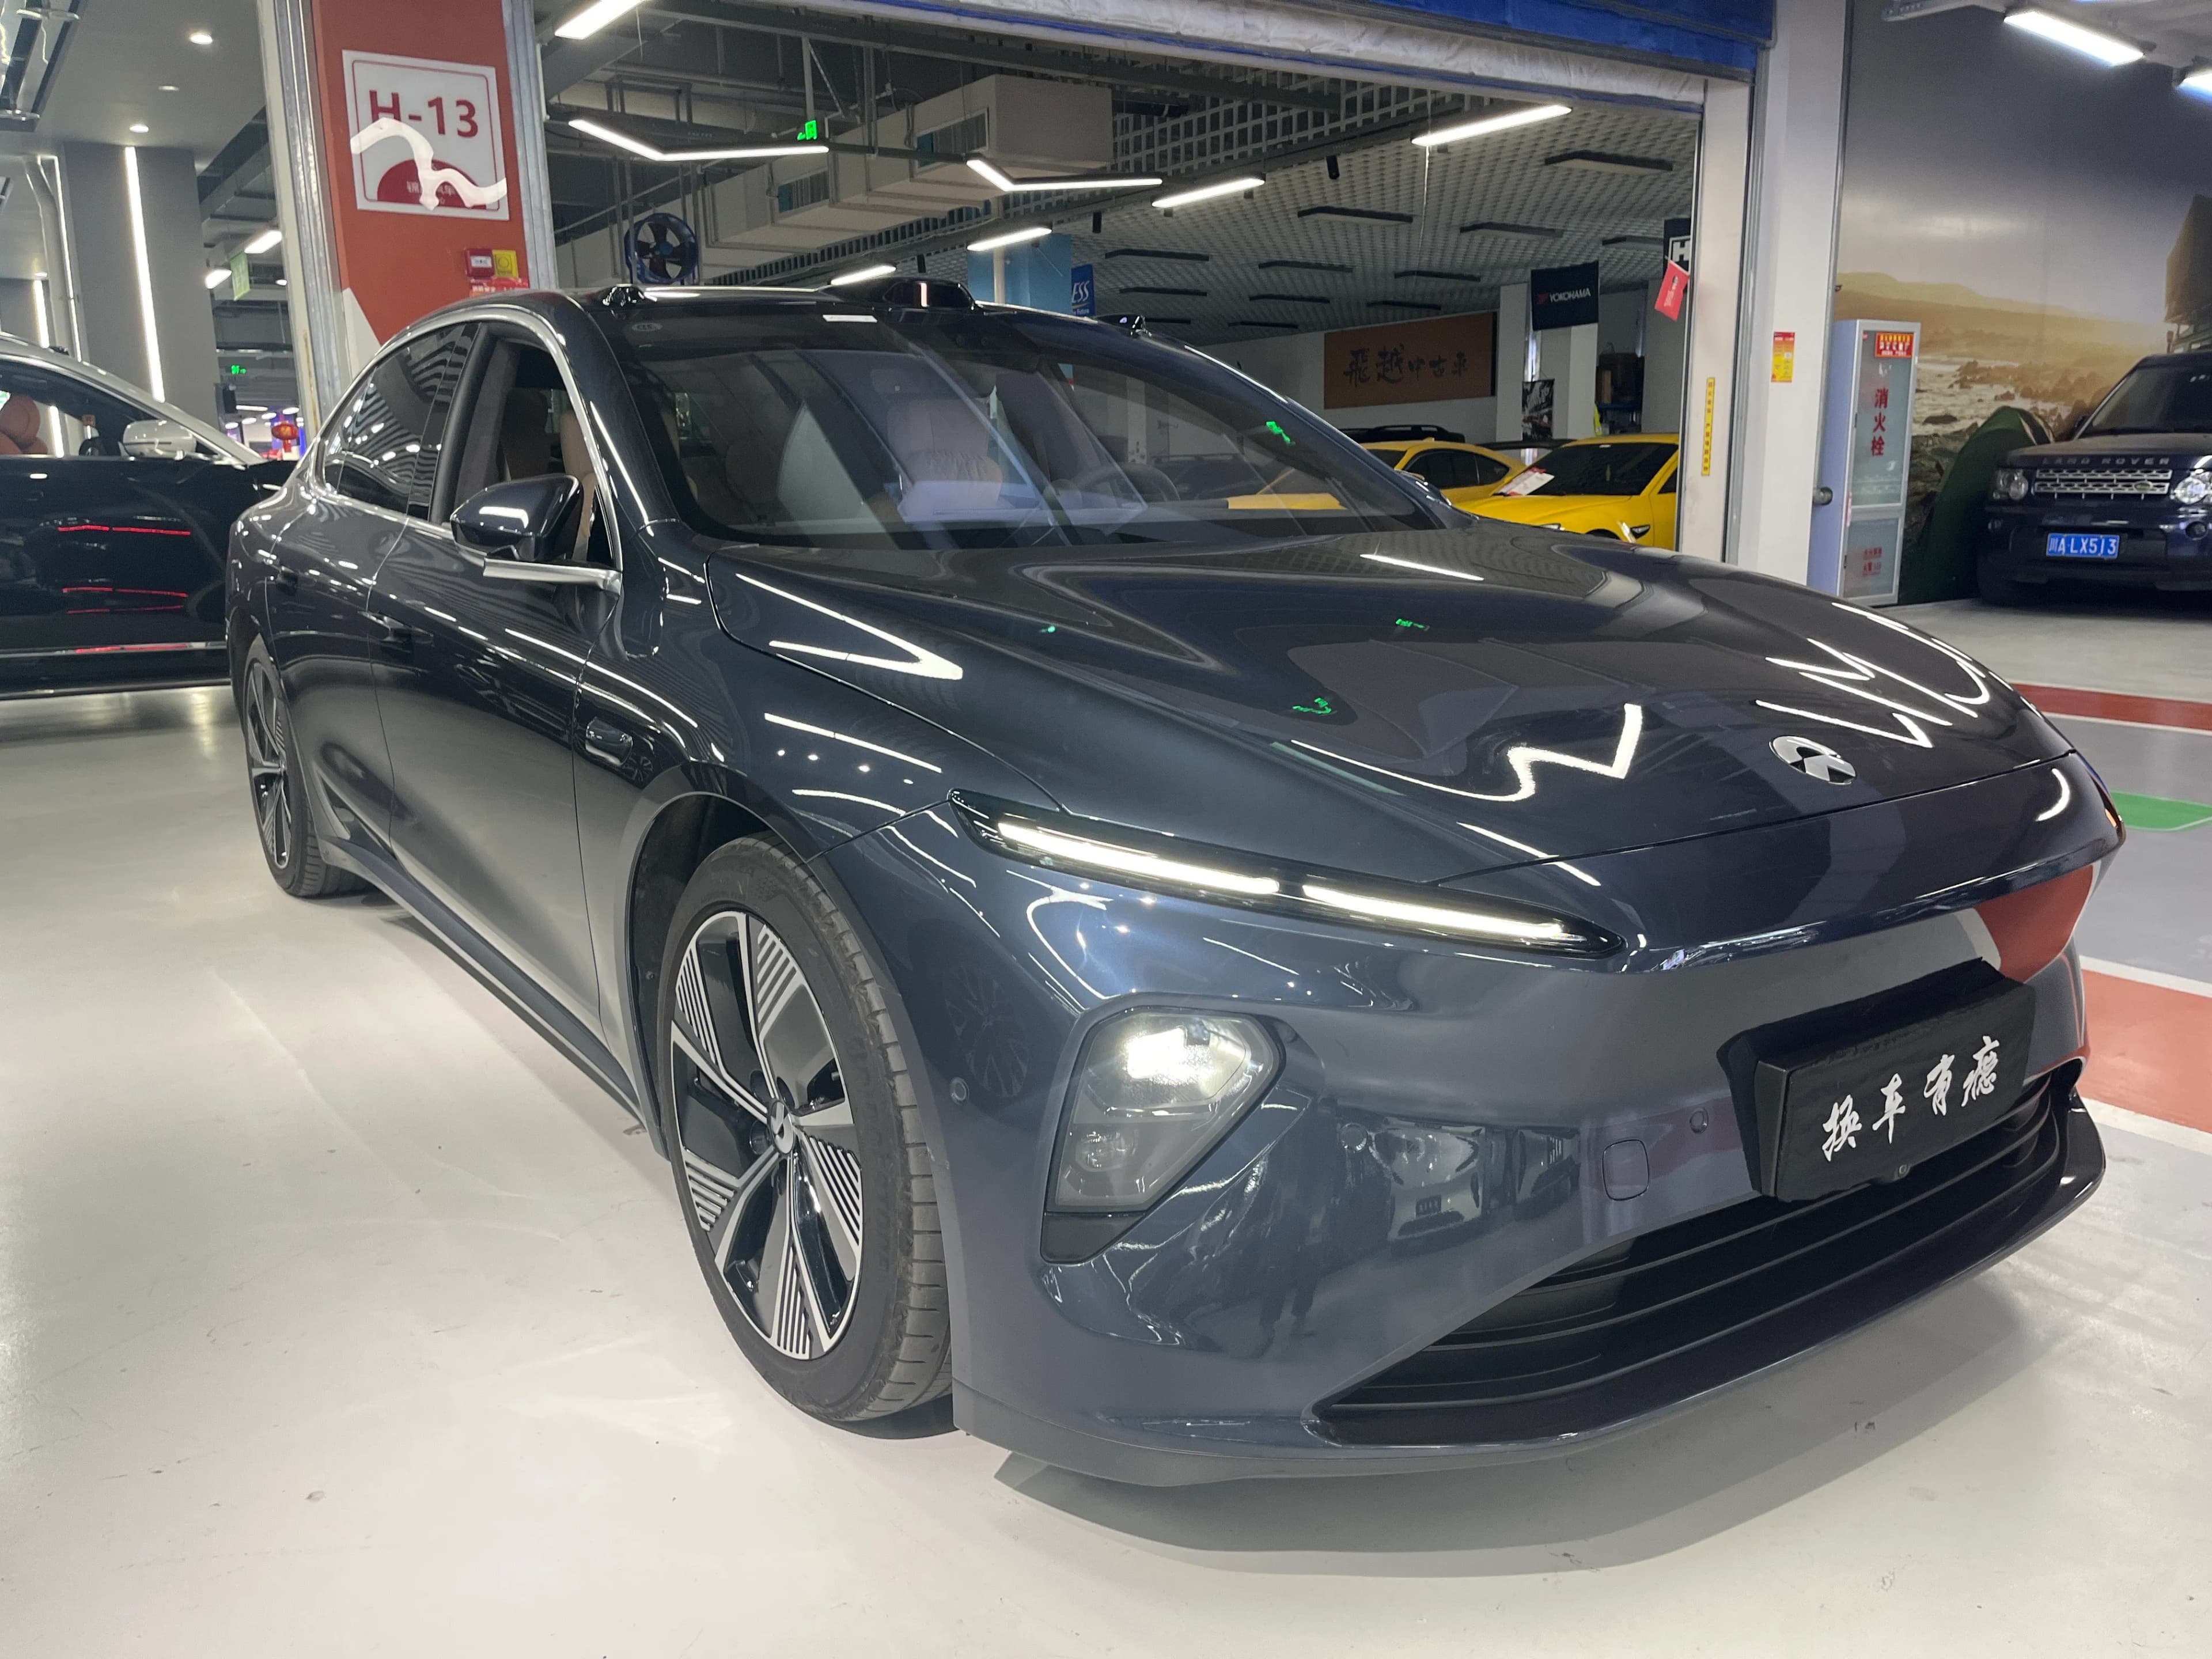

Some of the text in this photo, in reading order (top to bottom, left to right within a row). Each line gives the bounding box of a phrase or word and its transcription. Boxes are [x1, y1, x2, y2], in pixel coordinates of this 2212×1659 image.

[369, 90, 478, 138] H-13
[1550, 287, 1591, 303] YOKOHAMA
[1871, 387, 1889, 457] 消火栓
